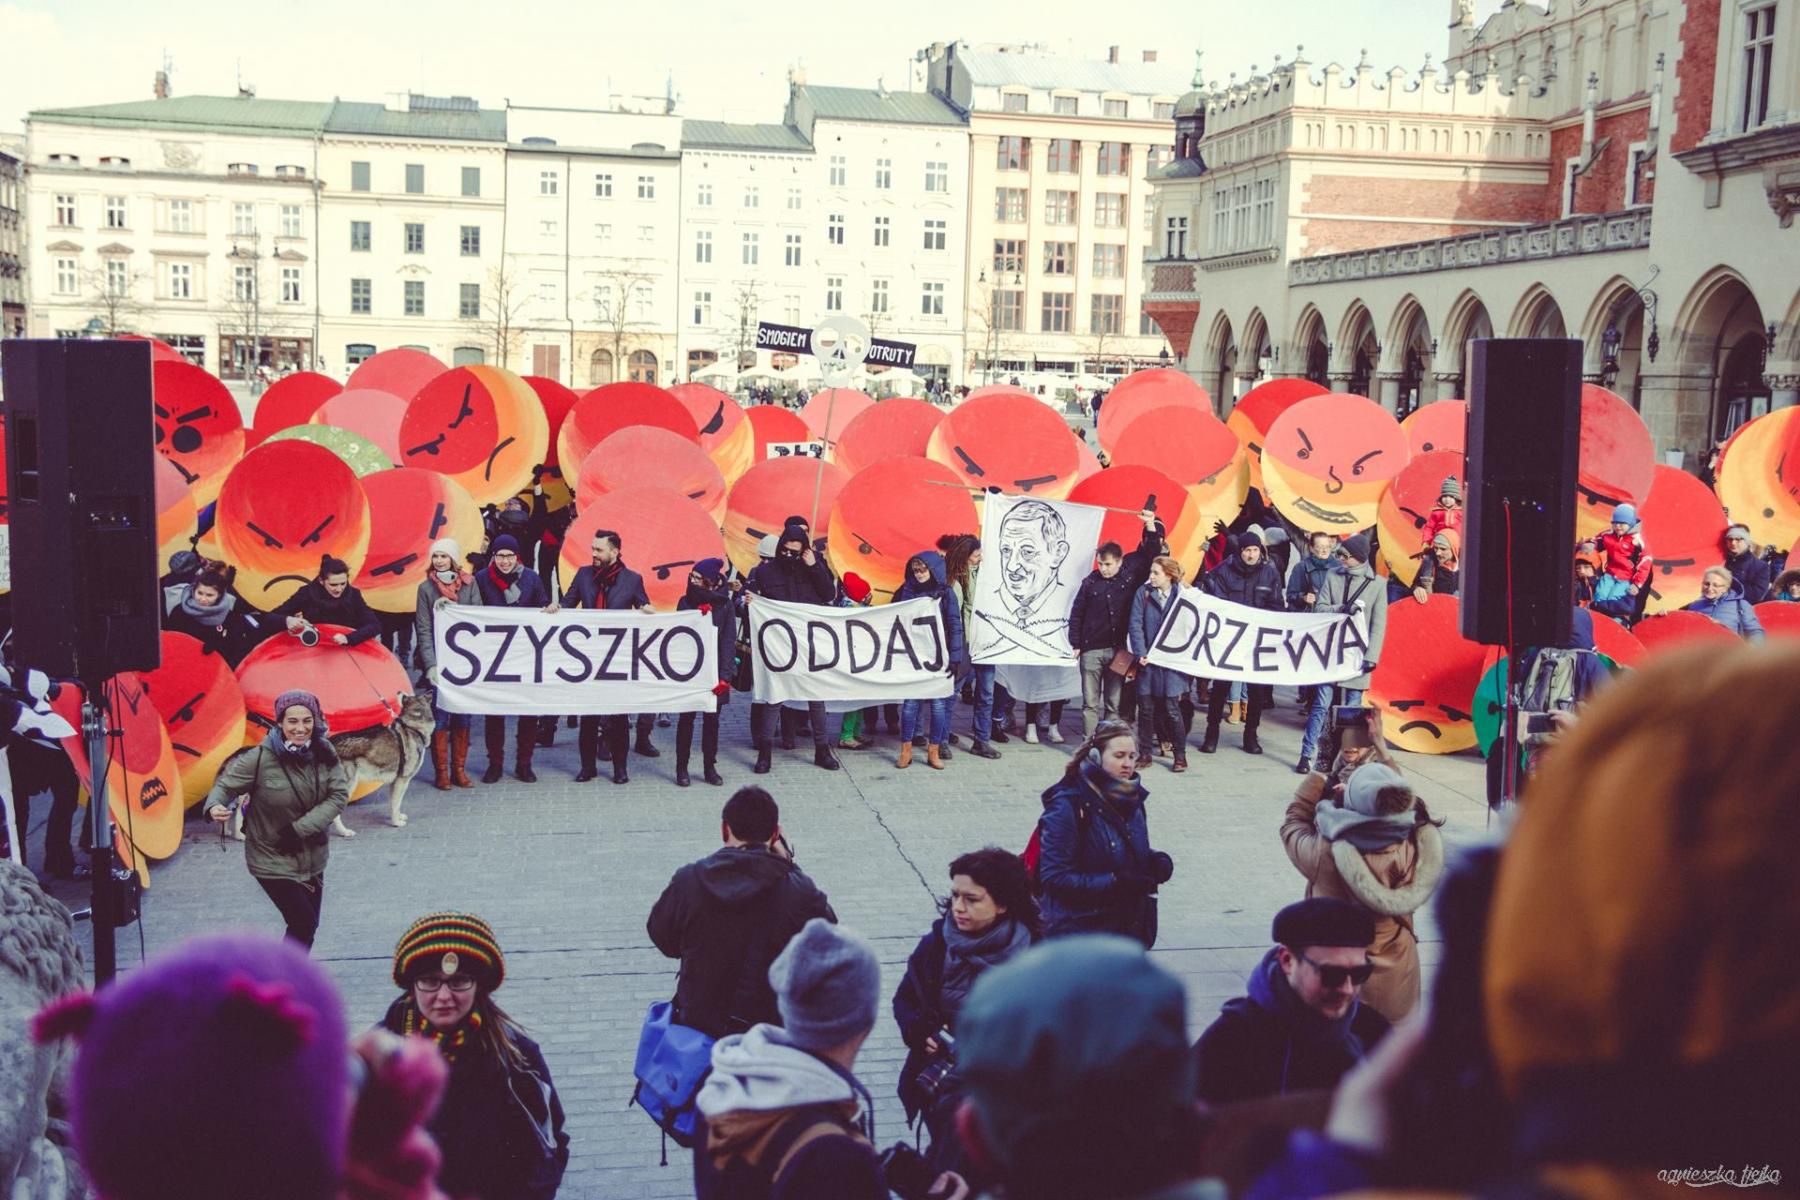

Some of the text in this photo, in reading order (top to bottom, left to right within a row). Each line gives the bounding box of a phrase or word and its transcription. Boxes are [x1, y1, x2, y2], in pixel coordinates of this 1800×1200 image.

[757, 327, 913, 364] SMOGIEM OTRUTY
[440, 621, 705, 686] SZYSZKO
[757, 614, 944, 674] ODDAJ
[1154, 597, 1369, 673] DRZEWA
